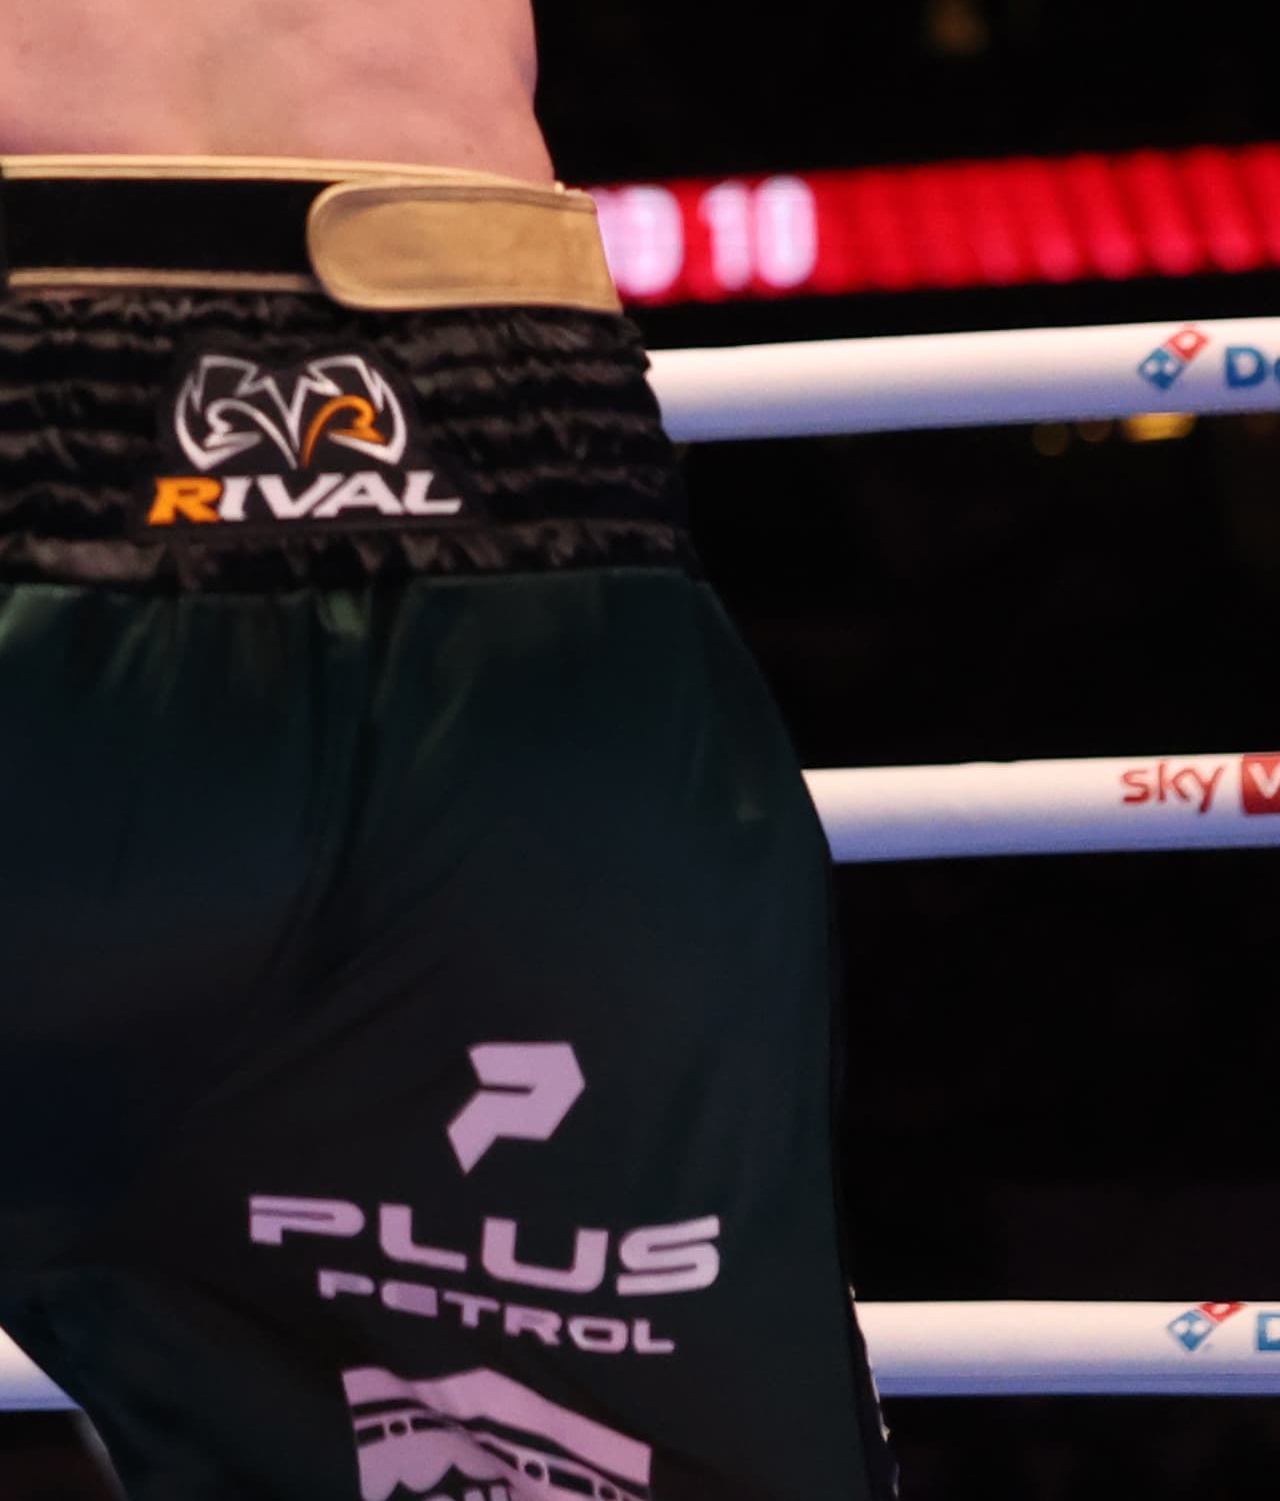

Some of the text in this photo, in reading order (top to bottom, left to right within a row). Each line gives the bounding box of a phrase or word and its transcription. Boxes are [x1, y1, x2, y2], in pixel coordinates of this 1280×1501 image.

[698, 175, 818, 292] 10
[146, 470, 462, 526] RIVAL
[1120, 760, 1223, 814] sky
[248, 1194, 721, 1297] PLUS
[317, 1269, 676, 1355] PETROL
